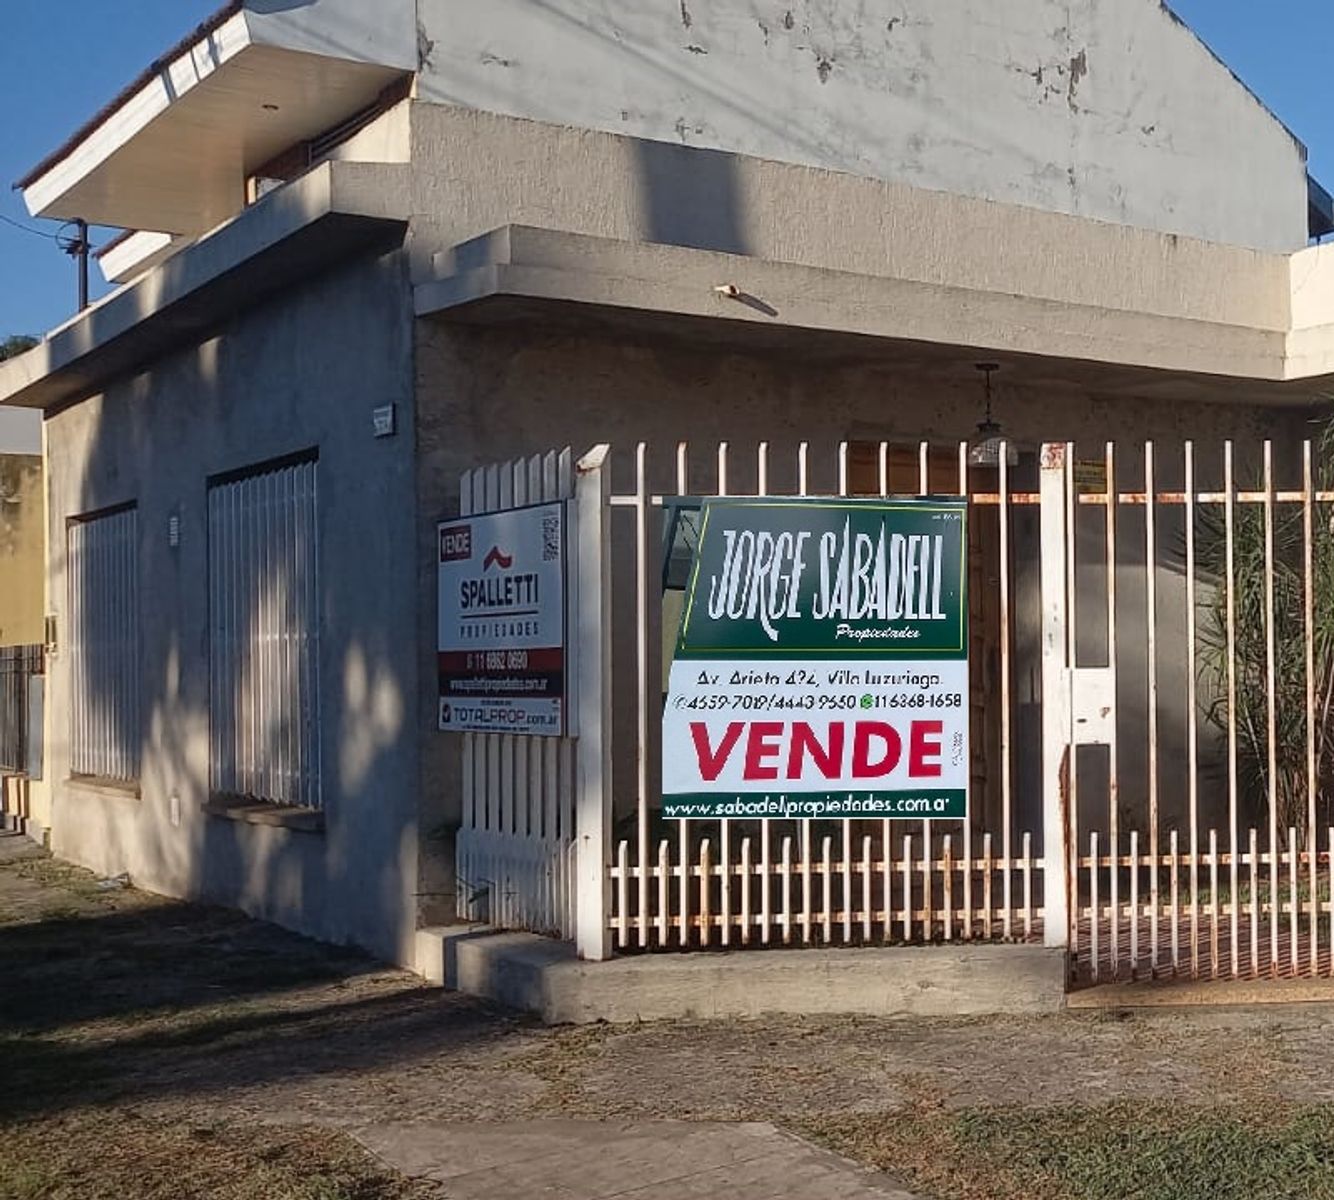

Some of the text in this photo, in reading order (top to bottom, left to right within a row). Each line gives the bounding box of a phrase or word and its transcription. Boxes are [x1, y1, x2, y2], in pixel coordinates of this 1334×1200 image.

[442, 532, 470, 554] VENDE
[460, 573, 539, 609] SPALLETTI
[708, 513, 946, 642] JORGE SABADELL
[460, 621, 539, 639] PROPIEDADES
[835, 623, 921, 642] Propiedades
[689, 720, 944, 782] VENDE
